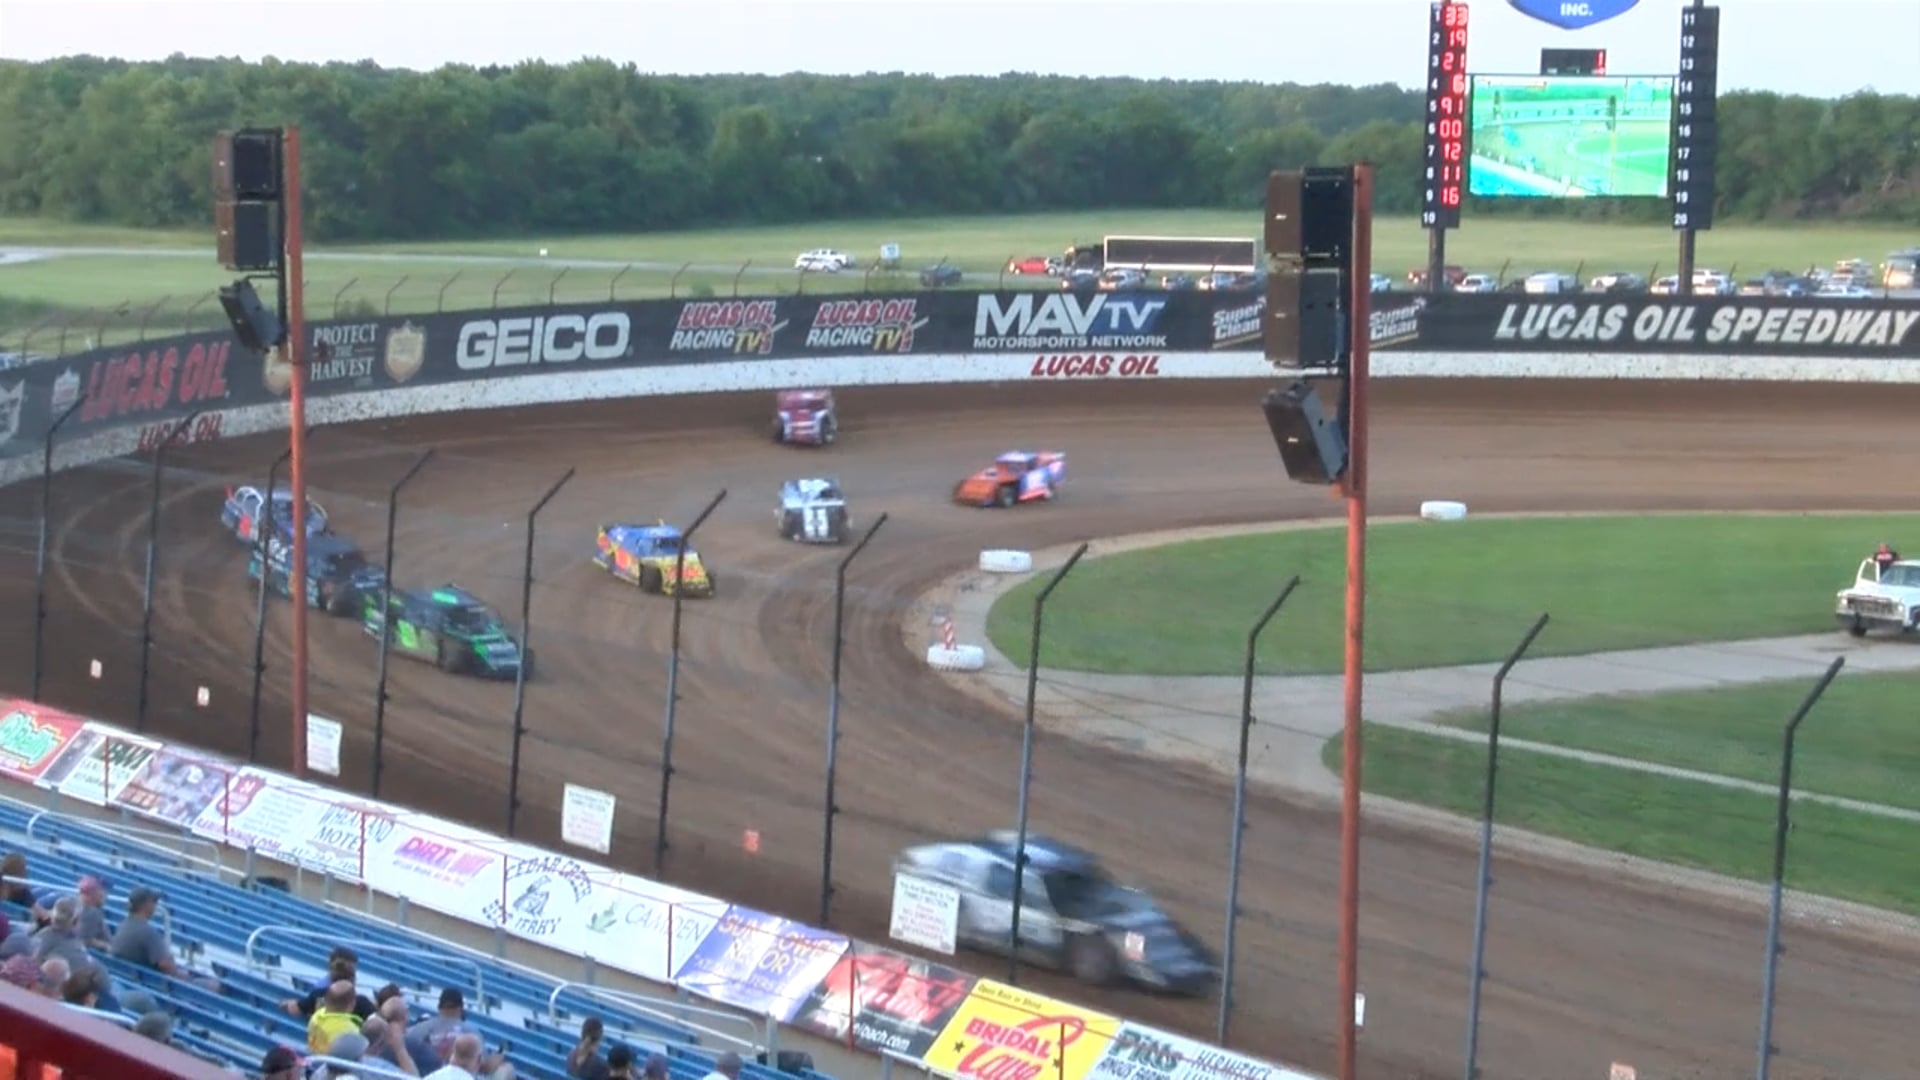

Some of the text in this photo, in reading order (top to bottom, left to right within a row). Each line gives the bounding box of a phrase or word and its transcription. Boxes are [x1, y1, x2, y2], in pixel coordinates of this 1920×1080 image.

[1435, 10, 1440, 22] 1
[1445, 6, 1467, 26] 33
[1561, 3, 1593, 16] INC.
[1684, 13, 1695, 26] 11
[1432, 29, 1466, 47] 2 19
[1683, 35, 1695, 48] 12
[1432, 52, 1465, 70] 3 21
[1682, 57, 1694, 71] 13
[1431, 73, 1465, 94] 4 6
[1681, 80, 1693, 93] 14
[1429, 97, 1464, 114] 5 91
[1680, 102, 1692, 115] 15
[1428, 119, 1462, 138] 6 00
[1679, 124, 1691, 137] 16
[1428, 143, 1461, 161] 7 12
[1678, 147, 1690, 160] 17
[1426, 166, 1461, 181] 8 11
[1677, 169, 1689, 182] 18
[1426, 187, 1460, 205] 9 16
[1676, 191, 1688, 204] 19
[1423, 211, 1436, 225] 10
[1674, 213, 1688, 226] 20
[677, 300, 776, 329] LUCAS OIL
[812, 298, 917, 328] LUCAS OIL
[1212, 303, 1263, 327] Super
[1369, 305, 1418, 326] Super
[1214, 317, 1261, 341] Clean
[1370, 319, 1418, 341] Clean
[1495, 303, 1920, 346] LUCAS OIL SPEEDWAY
[312, 322, 379, 346] PROTECT
[456, 311, 632, 370] GEICO
[670, 328, 738, 350] RACING
[805, 326, 875, 347] RACING
[973, 334, 1168, 349] MOTORSPORTS NETWORK
[310, 356, 375, 382] HARVEST
[1031, 355, 1160, 377] LUCAS OIL
[79, 346, 179, 422] LUCAS
[178, 340, 232, 403] OIL
[394, 836, 458, 869] DIRT
[964, 1017, 1052, 1059] BRIDAL
